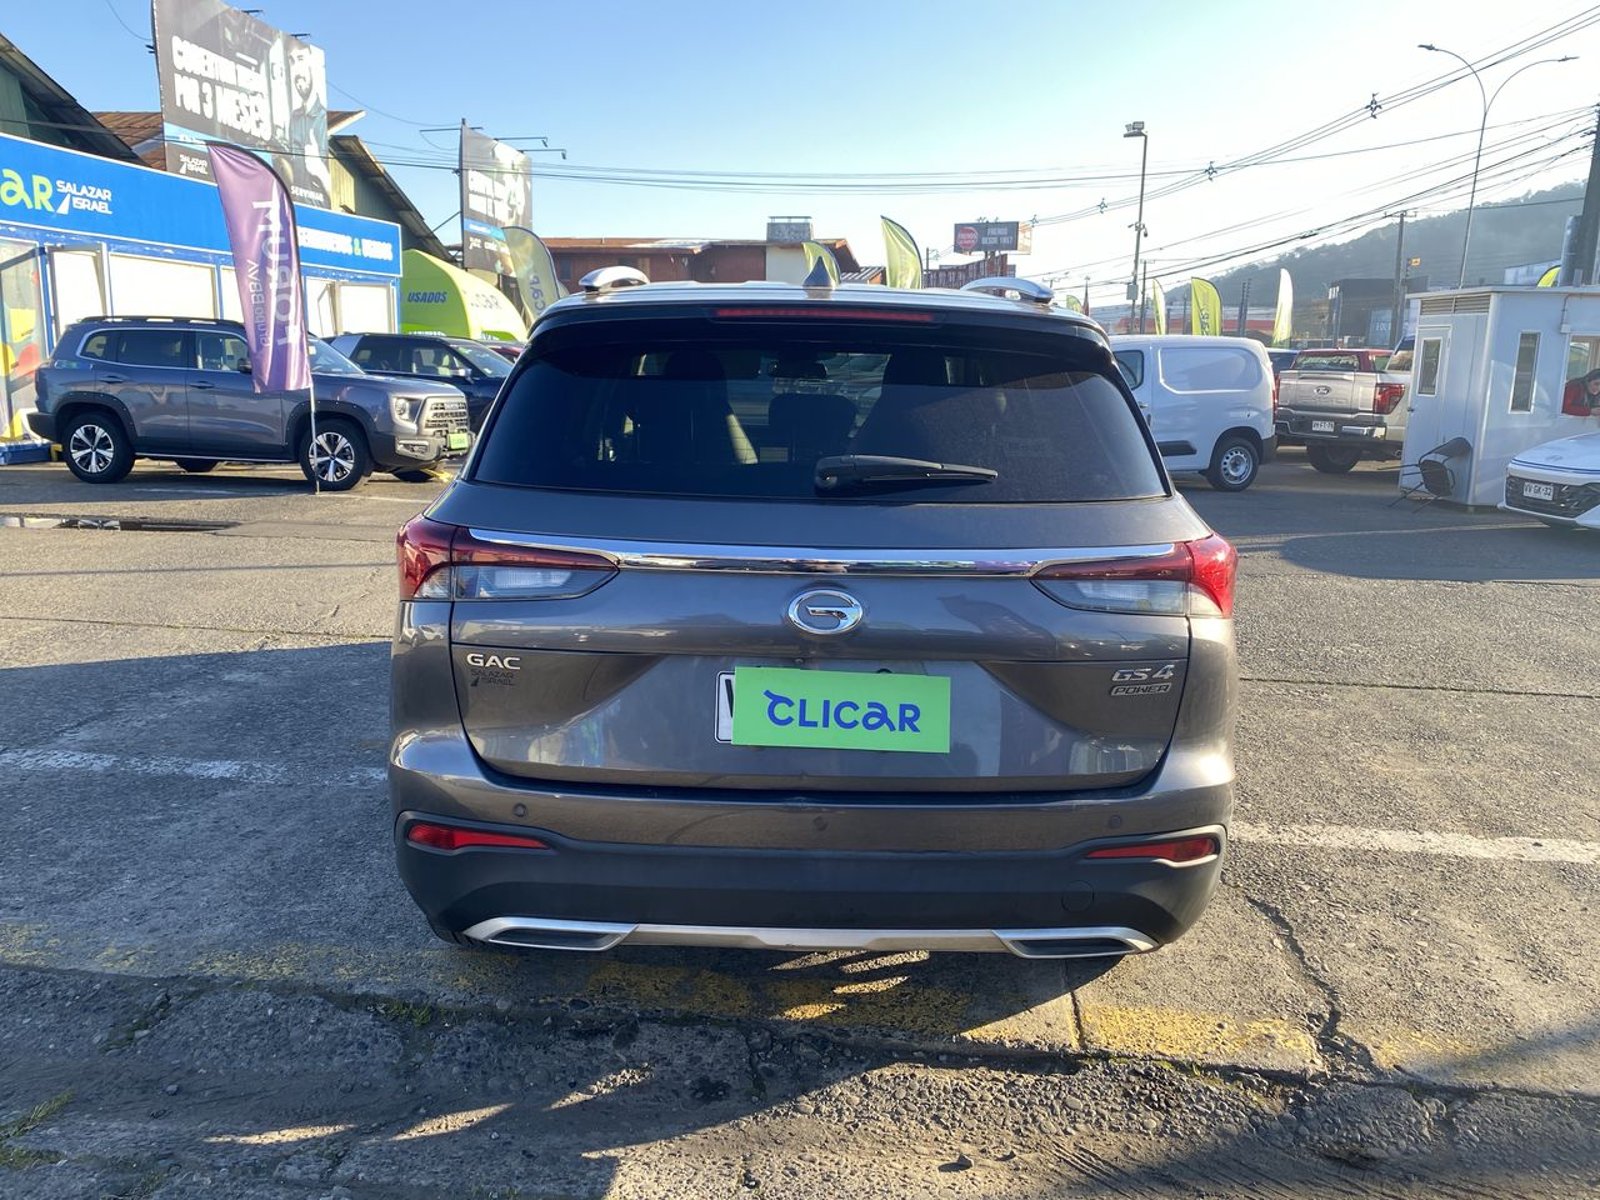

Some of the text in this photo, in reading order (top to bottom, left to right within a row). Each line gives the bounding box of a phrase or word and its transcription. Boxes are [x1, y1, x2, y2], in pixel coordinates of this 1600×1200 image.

[202, 82, 213, 119] 3
[56, 180, 113, 202] SALAZAR
[72, 196, 113, 215] ISRAEL
[407, 291, 447, 304] USADOS
[467, 653, 521, 670] GAC
[1114, 684, 1170, 696] POWER
